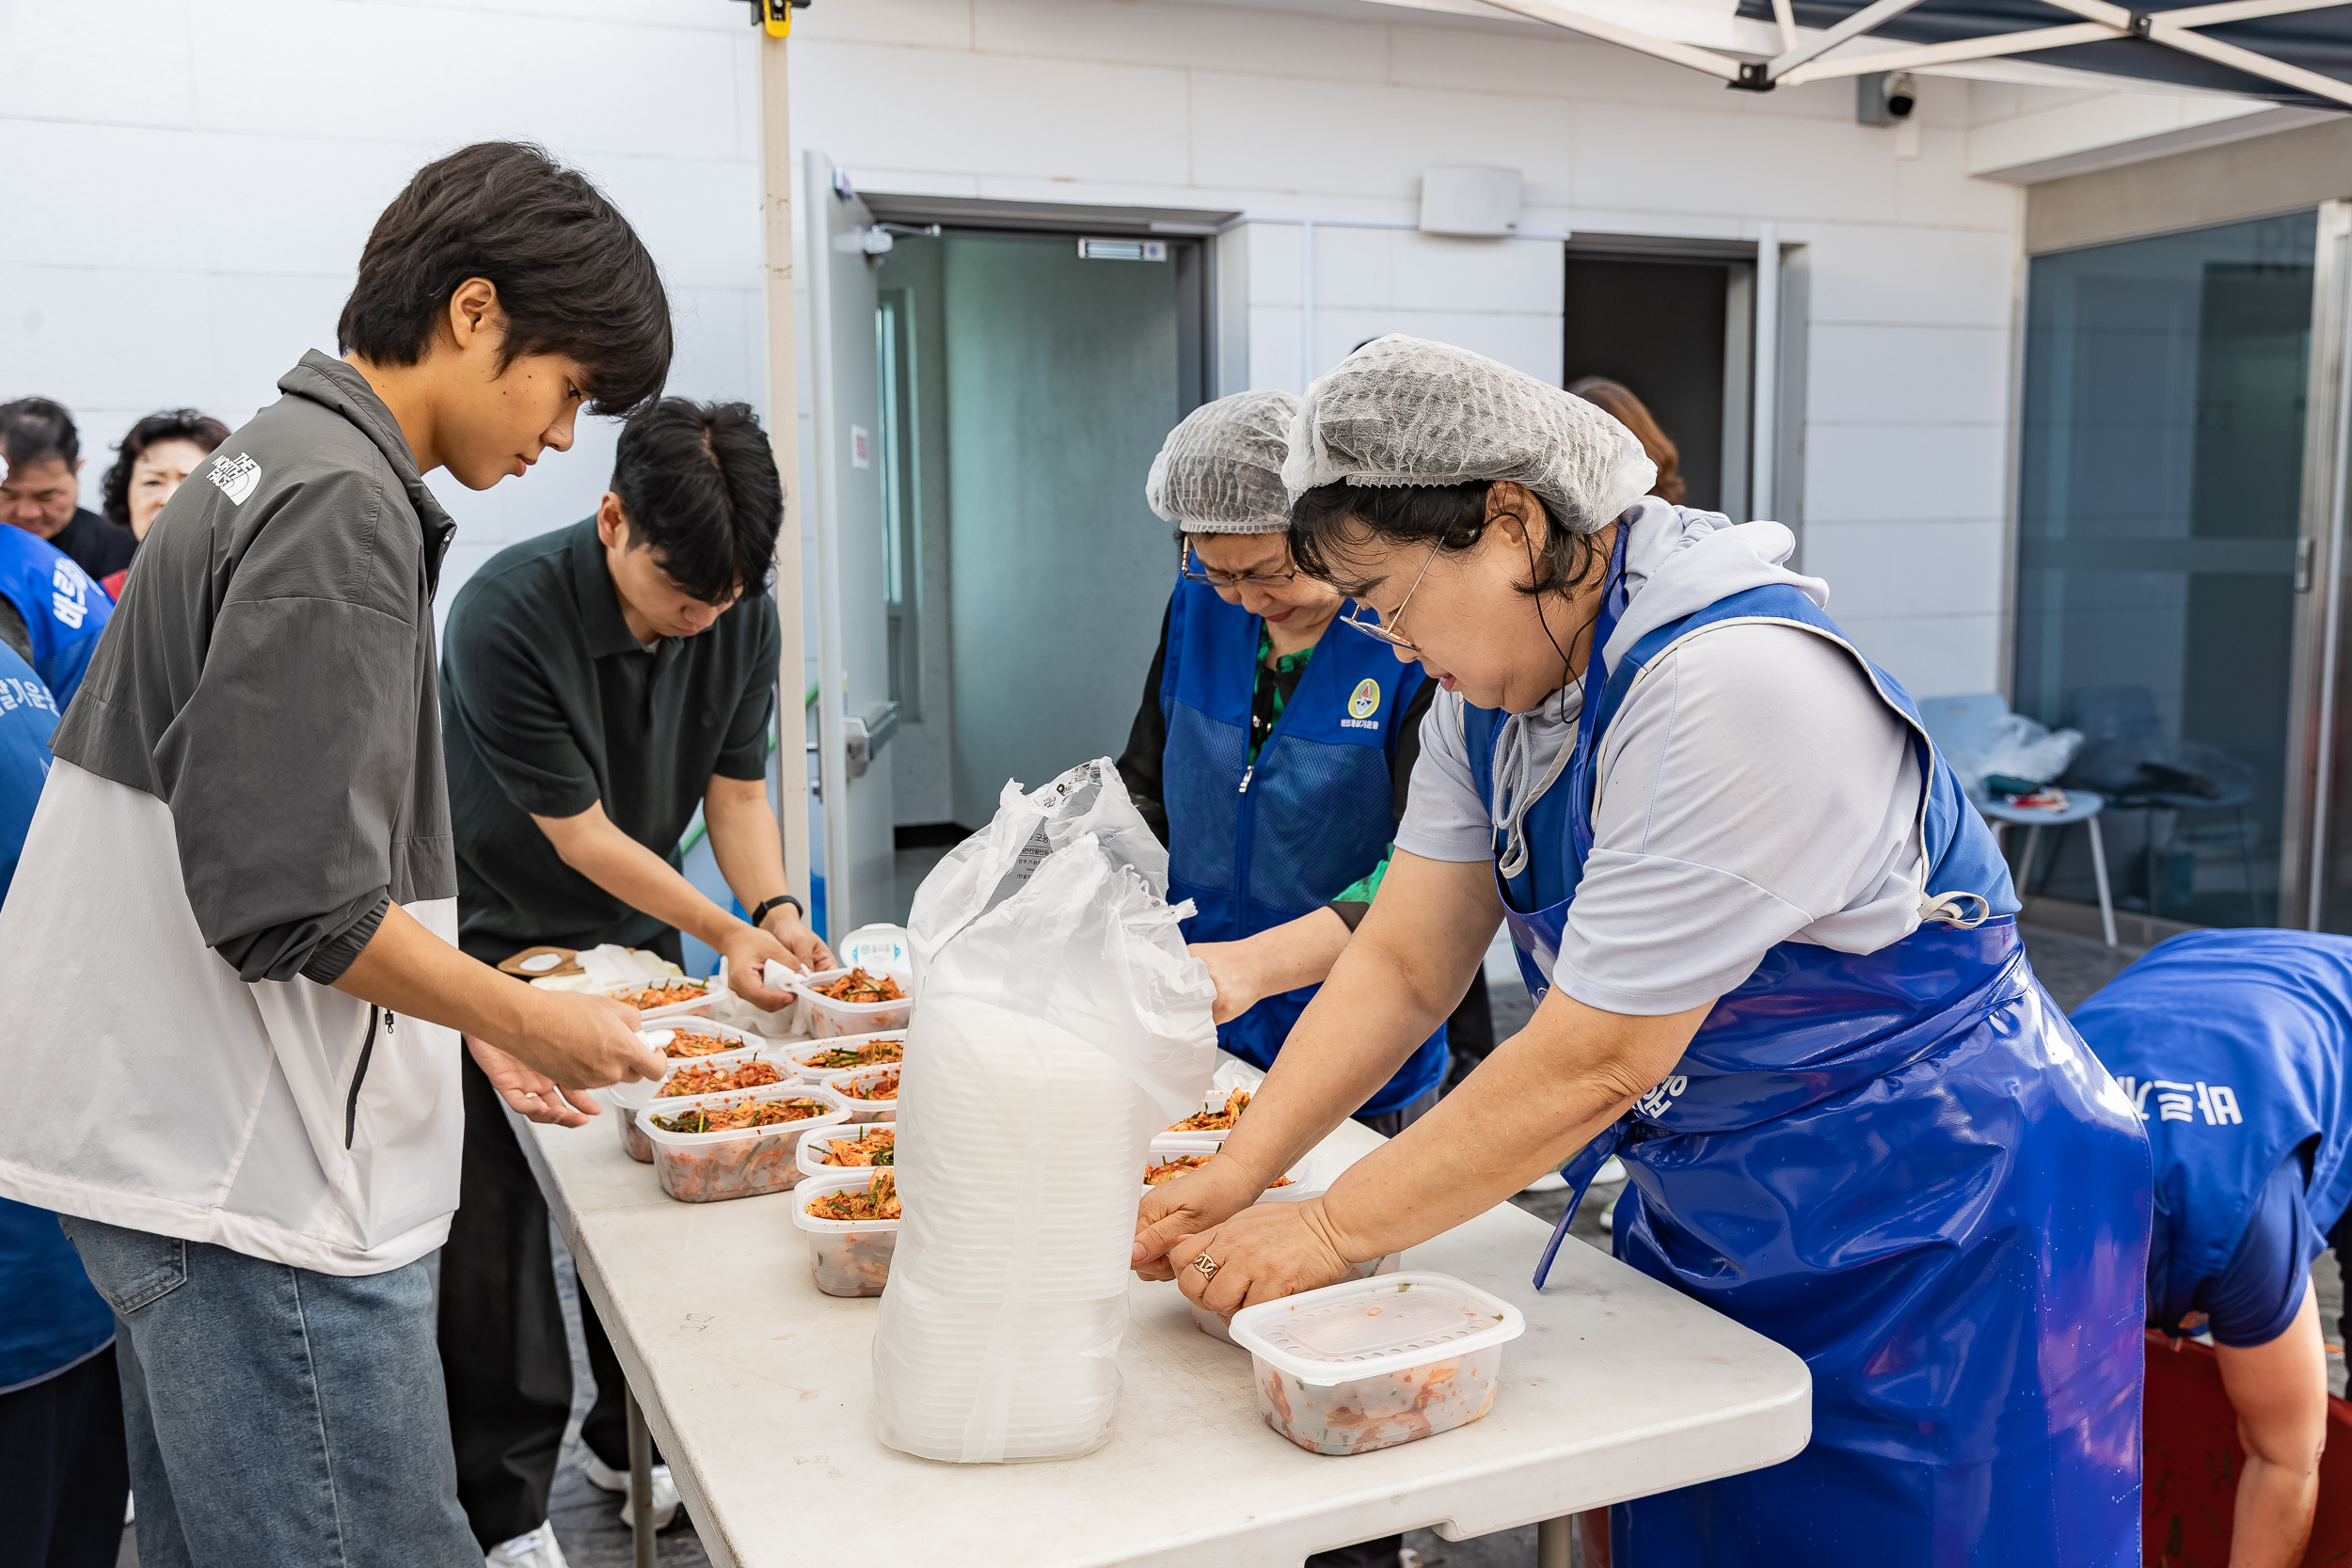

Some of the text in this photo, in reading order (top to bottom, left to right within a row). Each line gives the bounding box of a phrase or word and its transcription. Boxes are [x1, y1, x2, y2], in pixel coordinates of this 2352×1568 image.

[212, 454, 246, 480] NORTH
[233, 451, 258, 472] THE
[206, 467, 233, 490] FACE
